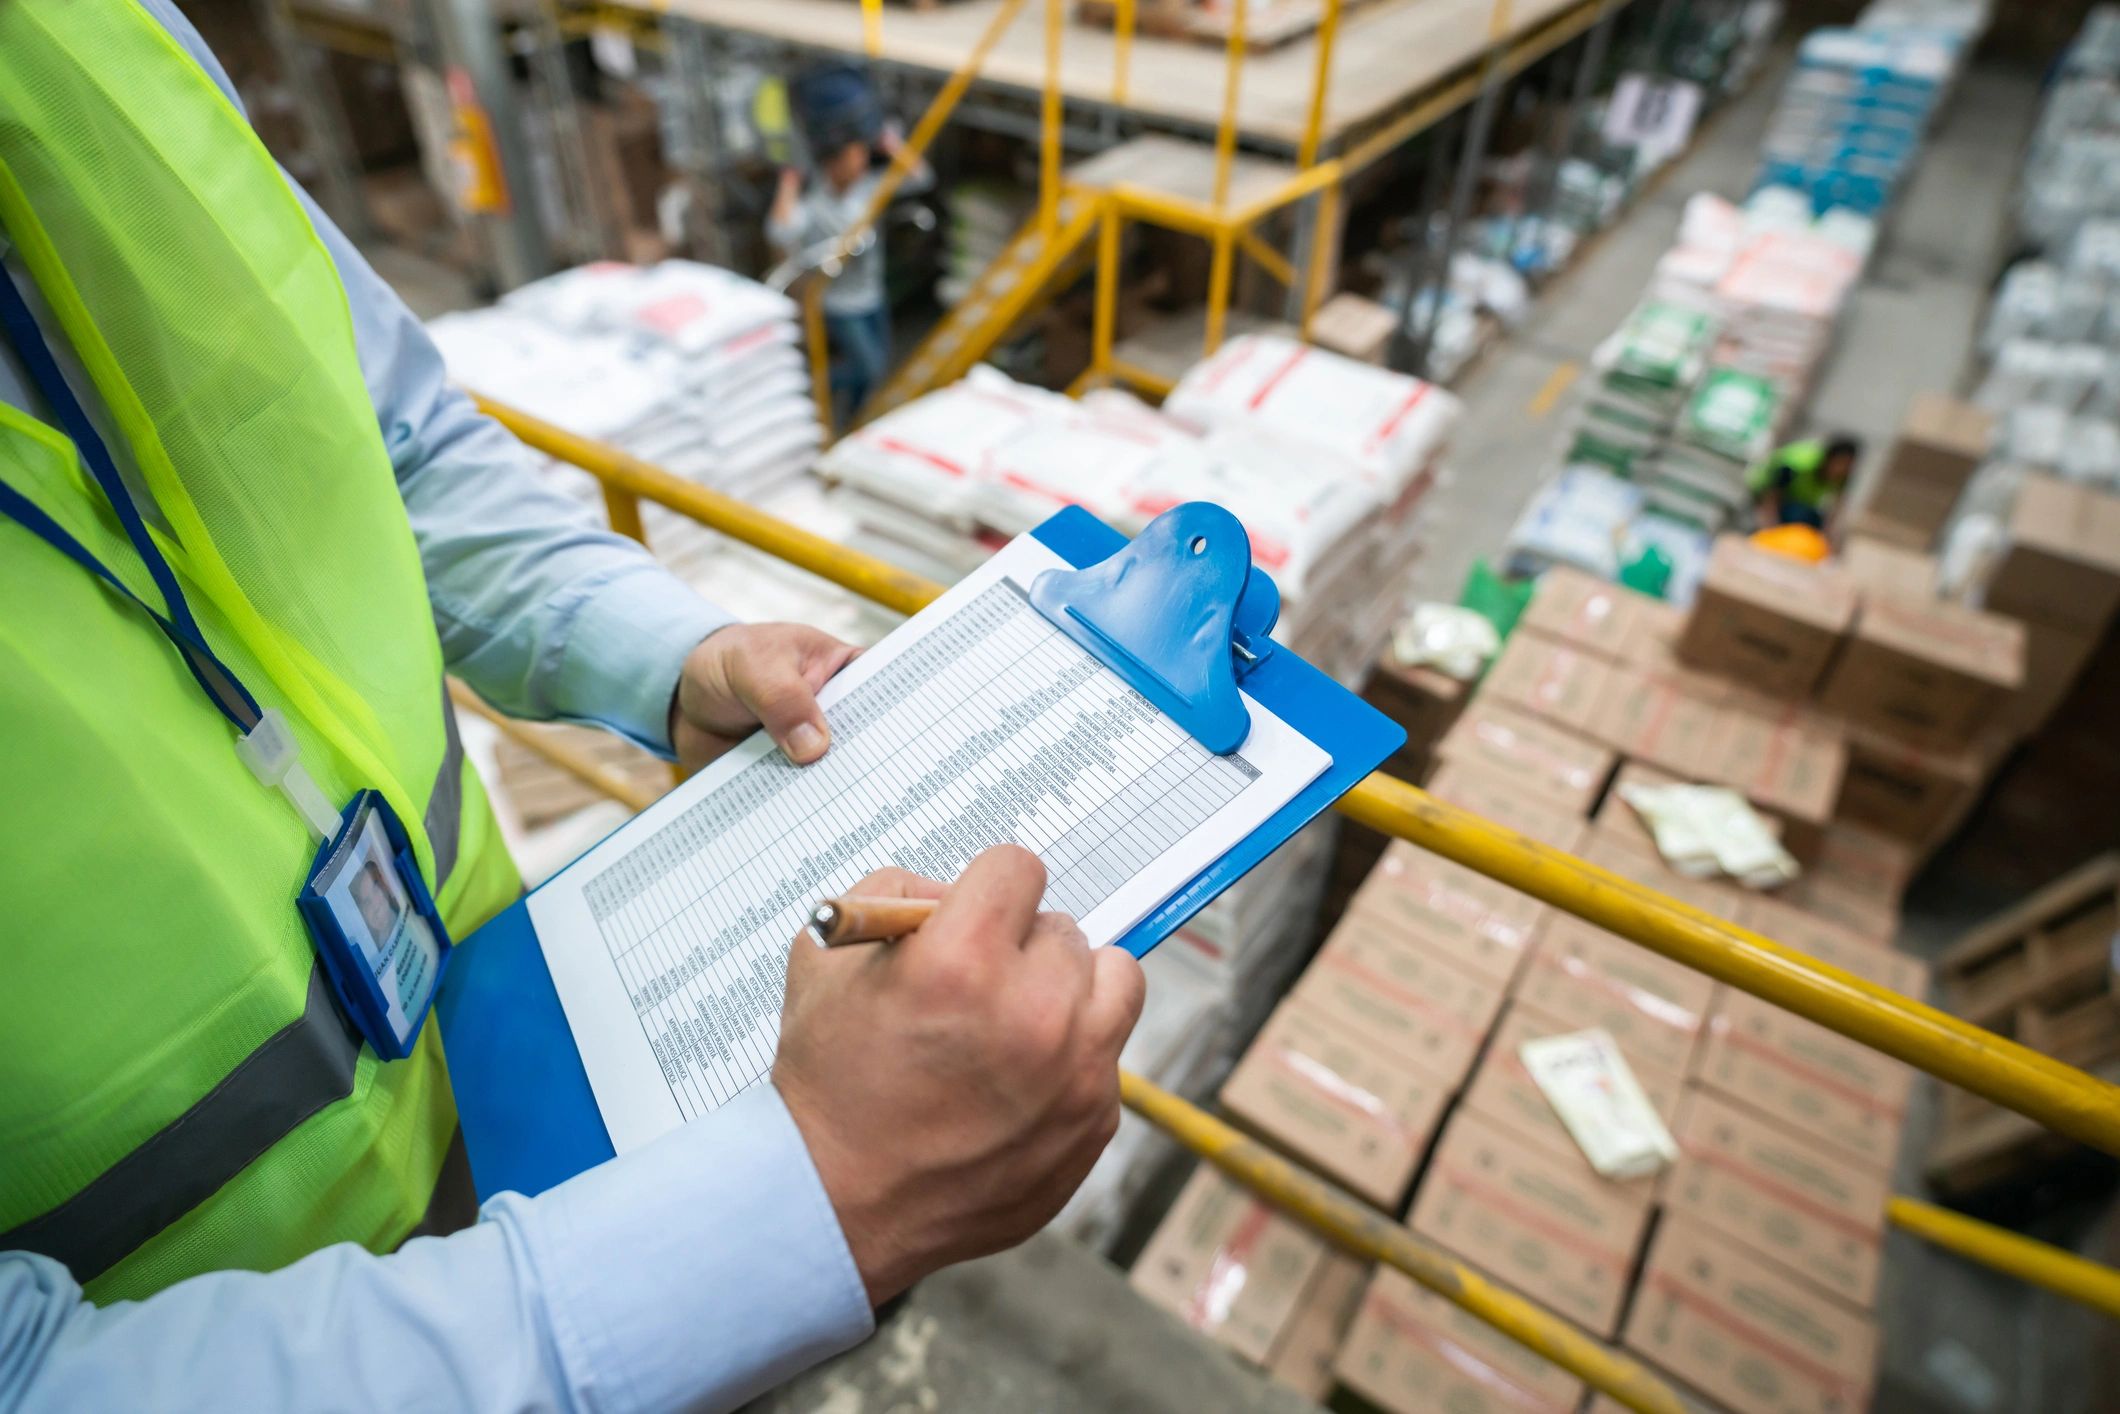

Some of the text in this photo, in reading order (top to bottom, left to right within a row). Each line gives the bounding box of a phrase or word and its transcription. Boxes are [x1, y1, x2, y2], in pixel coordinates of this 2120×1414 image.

[1115, 718, 1134, 734] ARAUCA
[1123, 712, 1135, 721] CALI
[1107, 724, 1124, 739] LETICIA
[1074, 750, 1093, 766] MELGAR
[1082, 743, 1116, 773] BUENAVENTURA
[1049, 769, 1069, 788] ARMENIA
[1057, 763, 1078, 781] BARBOSA
[1023, 789, 1039, 804] FUNZA
[1040, 776, 1072, 806] BUCARAMANGA
[998, 808, 1018, 829] DUITAMA
[1006, 802, 1021, 816] YOPAL
[989, 815, 1000, 826] SAN
[946, 848, 961, 864] PLATO
[954, 842, 973, 861] CARMEN
[919, 868, 931, 881] ARJ
[928, 862, 939, 873] SAN
[937, 855, 957, 877] TURBACO
[775, 979, 787, 994] ARJO
[757, 992, 774, 1016] BOGOTÁ
[766, 986, 774, 995] LA
[771, 993, 783, 1011] BOQU
[748, 1000, 761, 1018] PLATO
[729, 1014, 739, 1027] SAN
[735, 1024, 746, 1040] JUAN
[739, 1007, 755, 1033] TURBACO
[711, 1028, 718, 1038] LA
[720, 1021, 734, 1043] ARJONA
[692, 1043, 708, 1070] MEDELLIN
[701, 1035, 717, 1059] BOGOTÁ
[714, 1035, 731, 1063] BOQUILLA
[683, 1050, 692, 1064] CALI
[664, 1064, 676, 1085] LETICIA
[673, 1057, 687, 1080] ARAUCA
